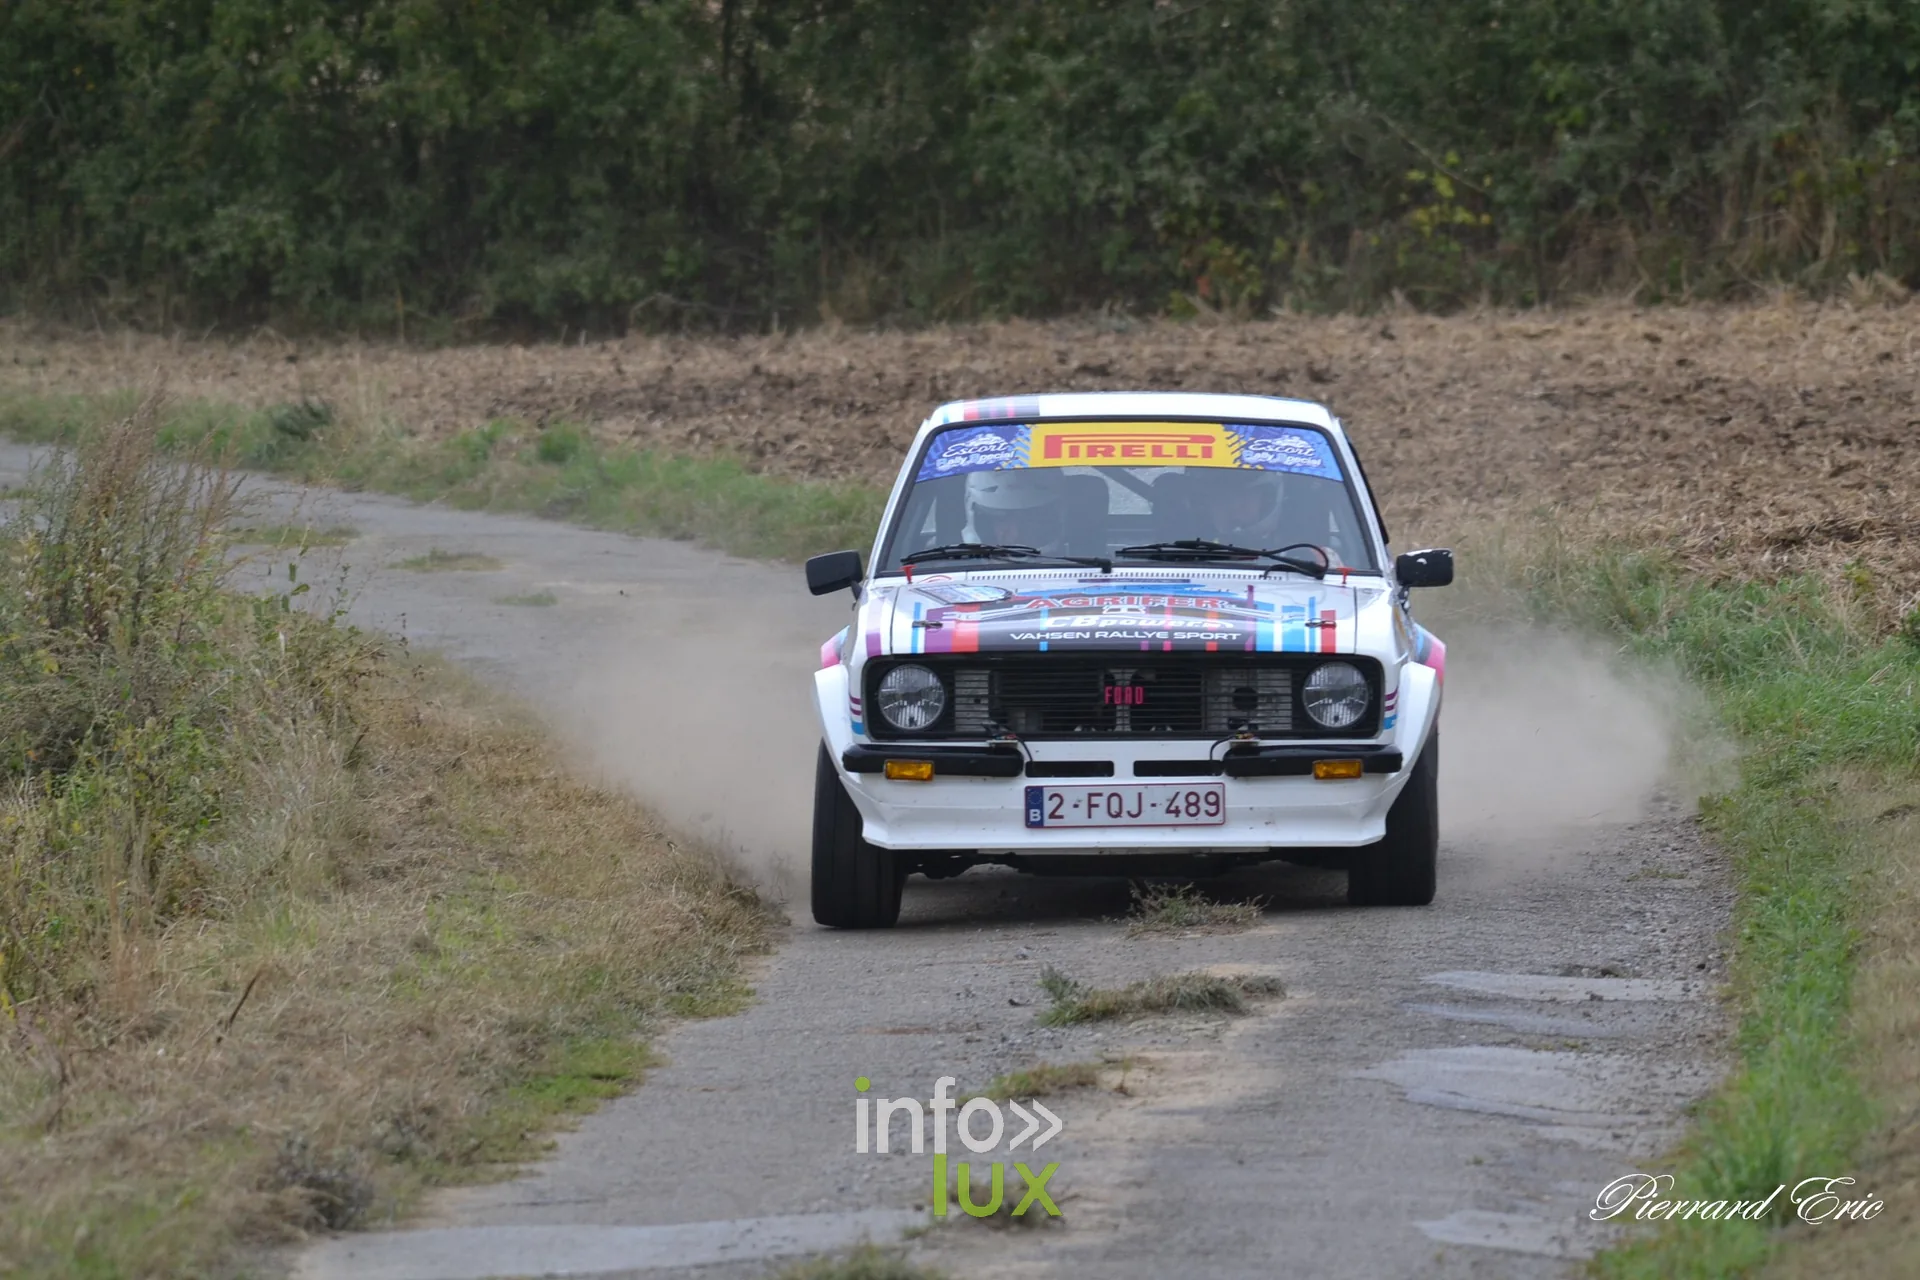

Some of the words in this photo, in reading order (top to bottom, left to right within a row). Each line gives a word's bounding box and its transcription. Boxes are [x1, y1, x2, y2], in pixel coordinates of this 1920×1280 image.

[942, 441, 1009, 458] Escort
[1044, 434, 1216, 459] PIRELLI
[1248, 439, 1316, 457] Escort
[1026, 596, 1221, 609] AGRIFER
[1010, 631, 1090, 640] VAHSEN
[1095, 631, 1169, 639] RALLYE
[1173, 631, 1241, 640] SPORT
[1048, 791, 1220, 819] 2-FQJ-489
[1029, 809, 1041, 822] B
